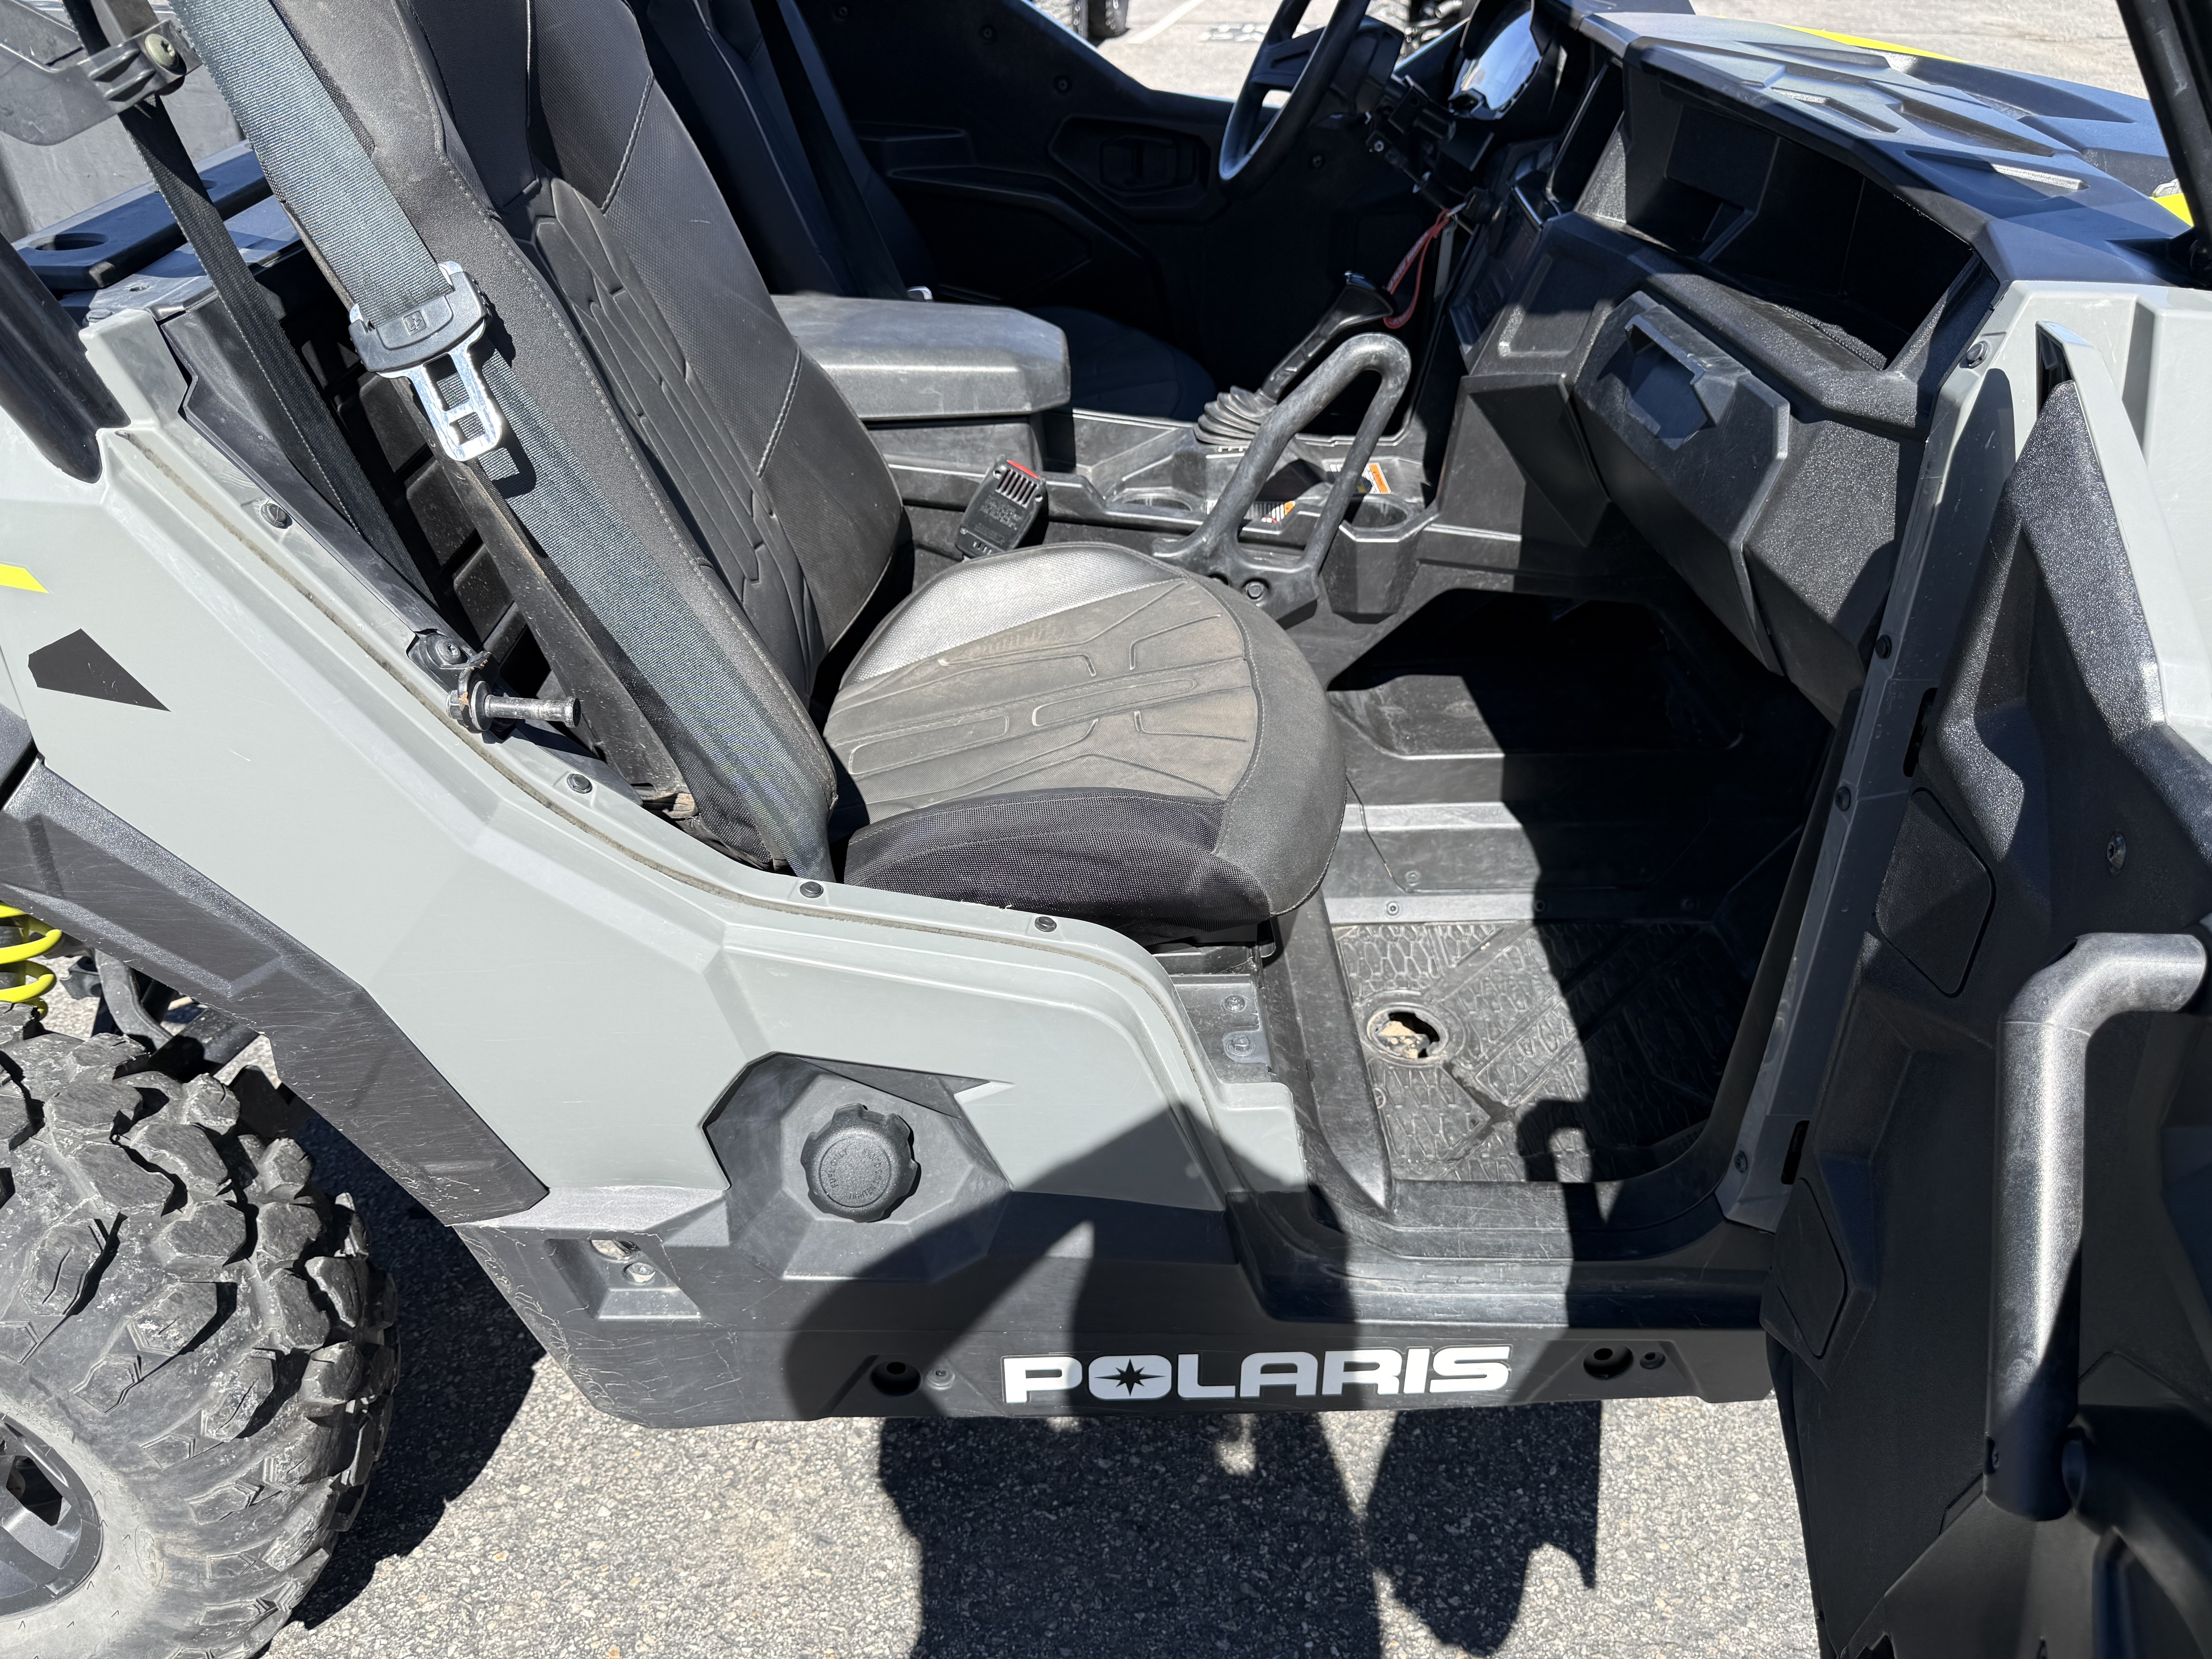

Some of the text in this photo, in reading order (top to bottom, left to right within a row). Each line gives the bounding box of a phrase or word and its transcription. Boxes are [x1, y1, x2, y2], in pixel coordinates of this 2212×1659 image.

[828, 1148, 848, 1188] FUEL ONLY
[1003, 1346, 1513, 1405] POLARIS
[22, 1401, 73, 1434] NYLON
